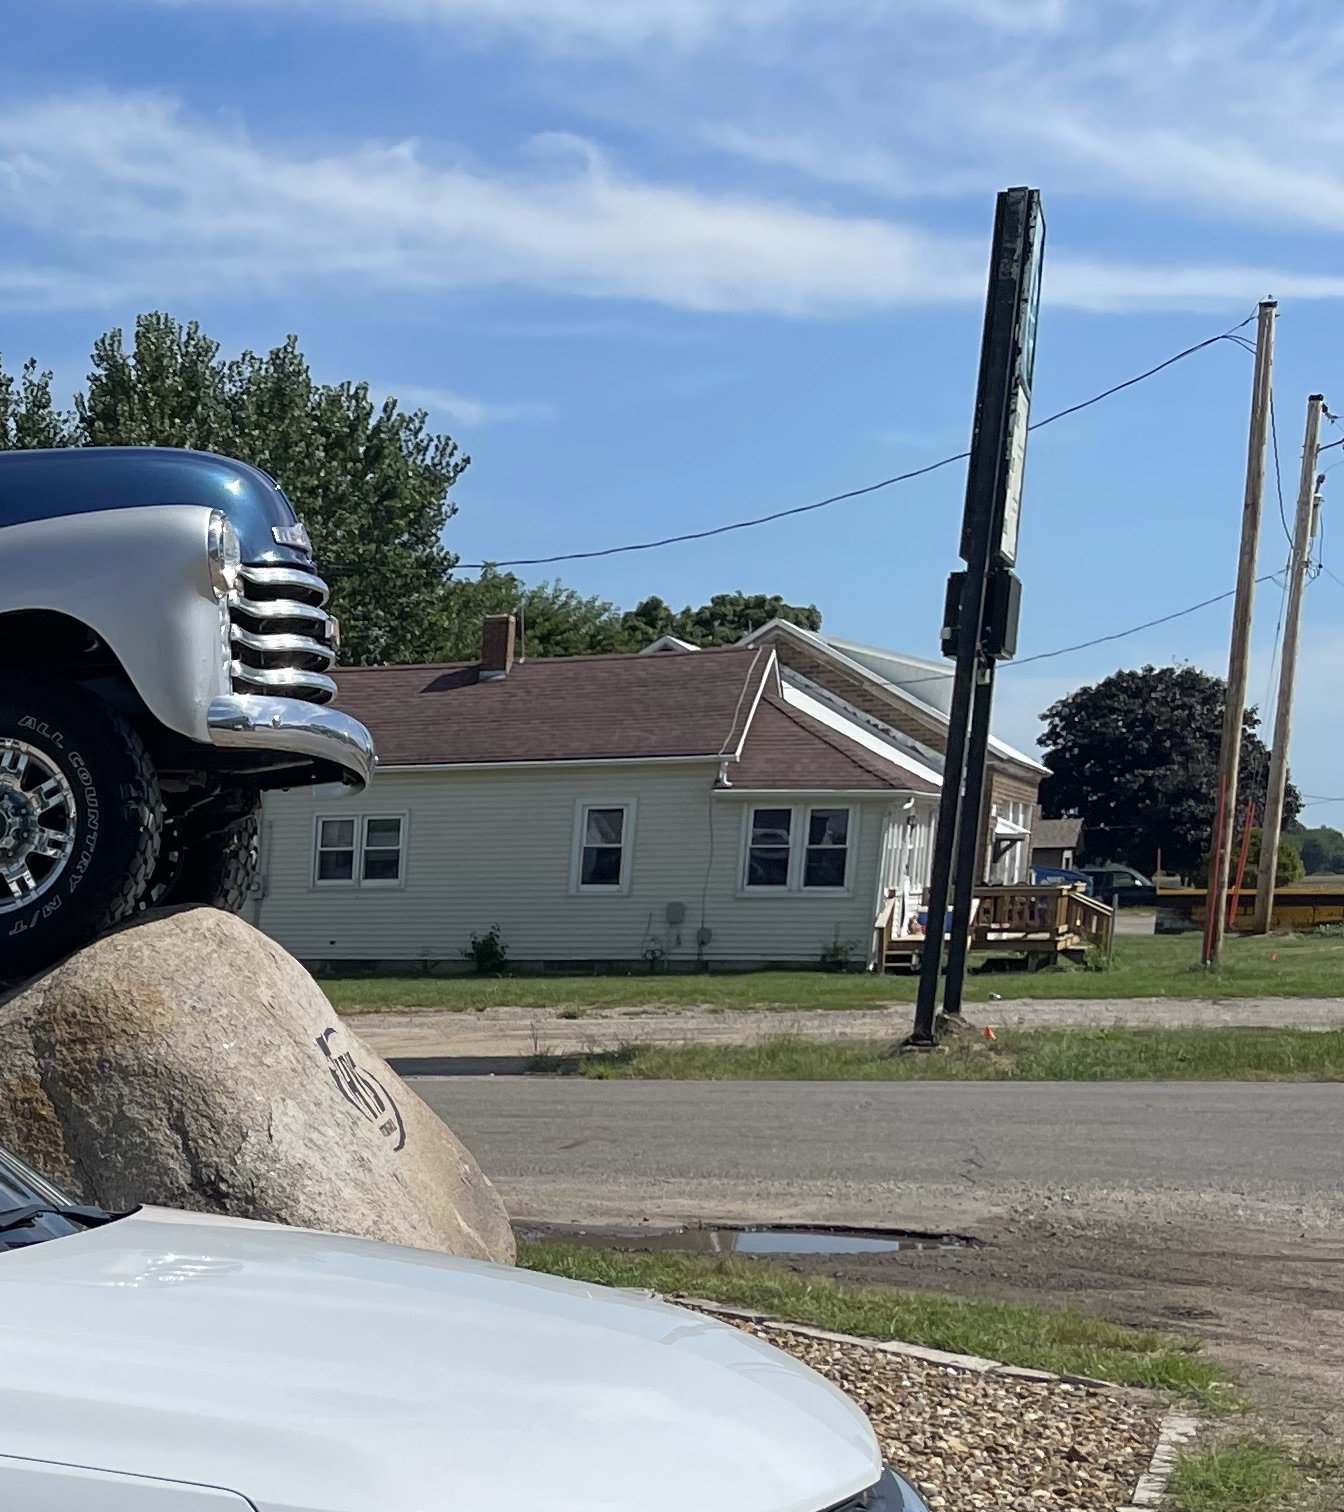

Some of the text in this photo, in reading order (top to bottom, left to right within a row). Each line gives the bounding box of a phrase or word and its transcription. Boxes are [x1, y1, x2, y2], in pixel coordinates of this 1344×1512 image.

[8, 715, 100, 937] ALL COUNTRY M/T
